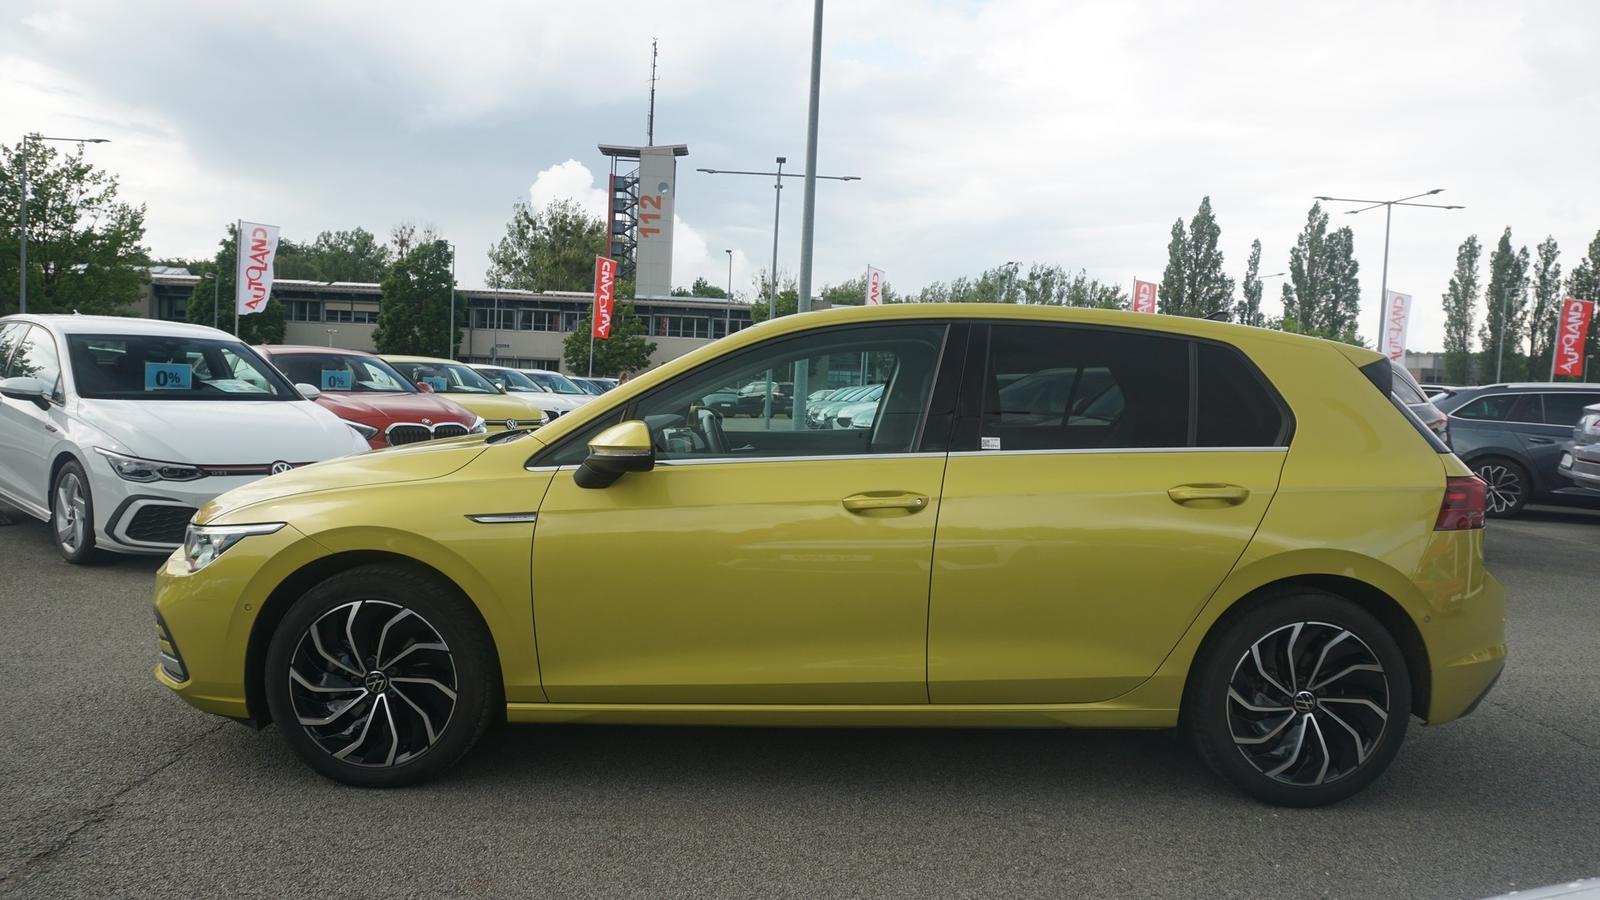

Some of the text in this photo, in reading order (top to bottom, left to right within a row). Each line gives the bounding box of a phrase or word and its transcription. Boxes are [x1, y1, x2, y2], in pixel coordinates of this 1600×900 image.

[639, 195, 661, 238] 112
[244, 227, 270, 309] AUTOLAND
[1560, 302, 1584, 374] AUTOLAND
[156, 370, 181, 387] 0%
[328, 375, 345, 388] 0%
